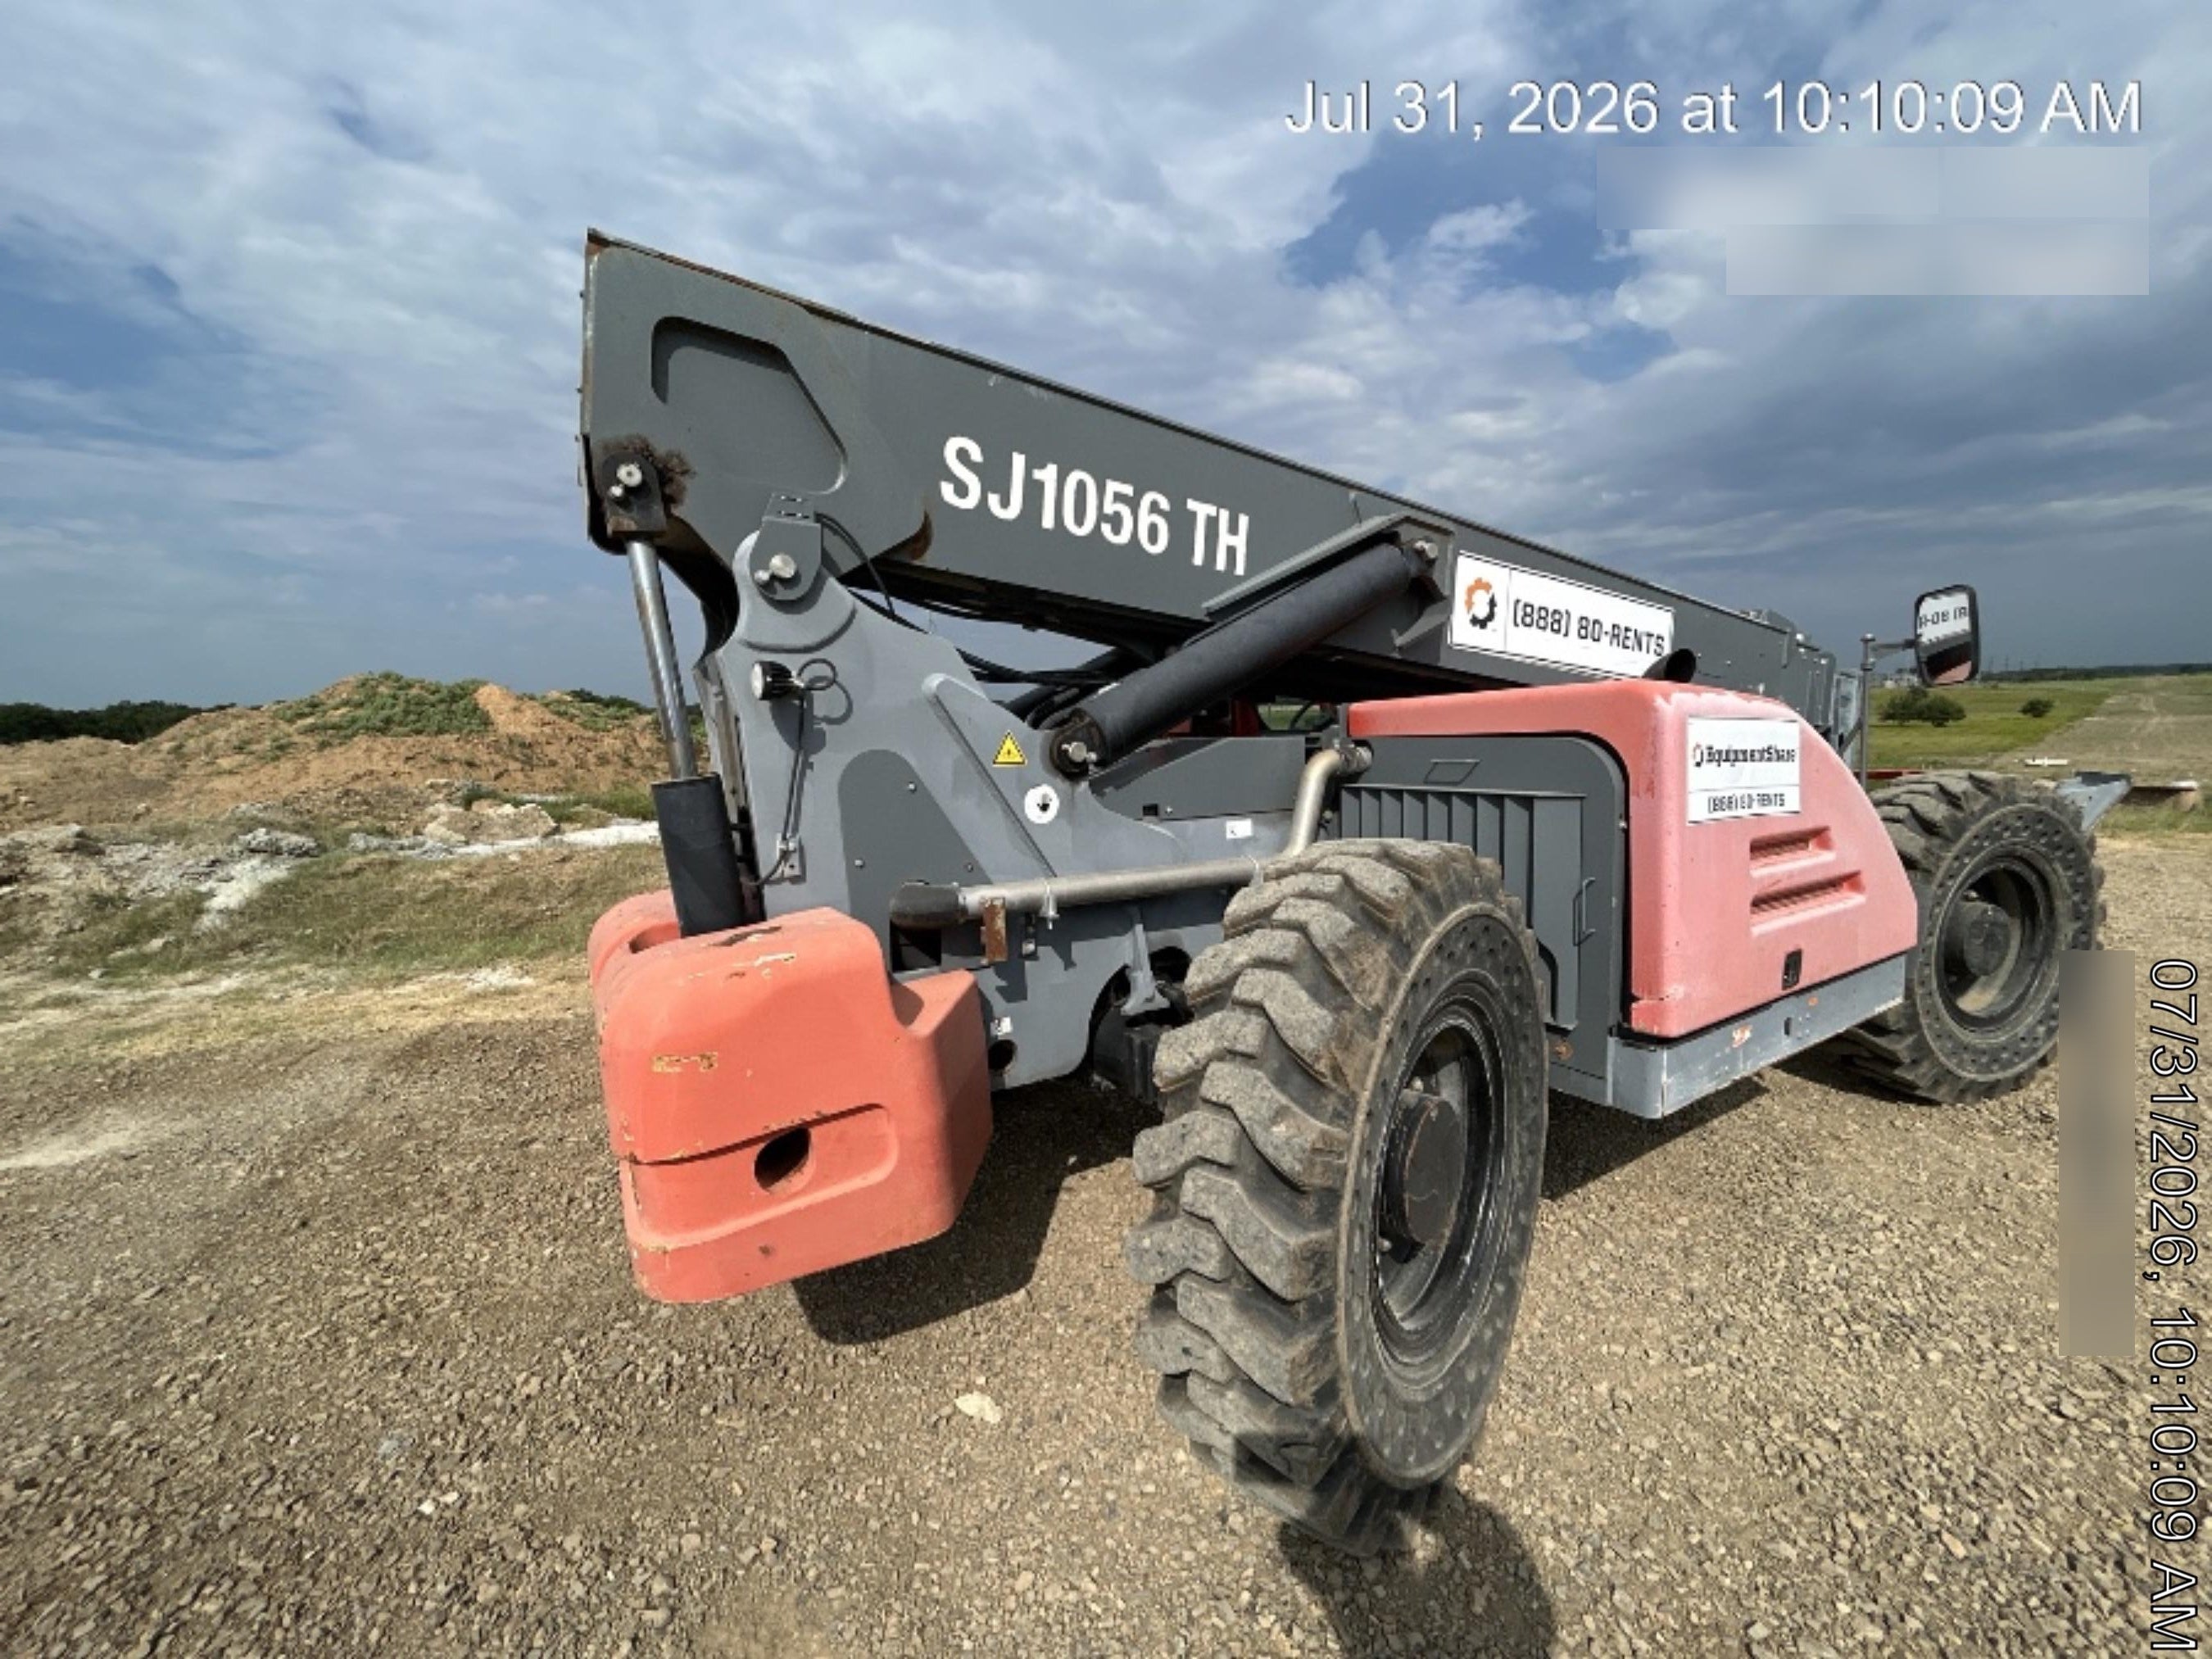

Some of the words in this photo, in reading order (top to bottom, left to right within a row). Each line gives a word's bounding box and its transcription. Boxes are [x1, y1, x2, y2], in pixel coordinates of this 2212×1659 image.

[940, 437, 1171, 555] SJ1056
[1186, 498, 1249, 576] TH
[1513, 599, 1571, 637] (888)
[1577, 616, 1665, 656] 80-RENTS
[1706, 745, 1795, 767] EquipmentShare
